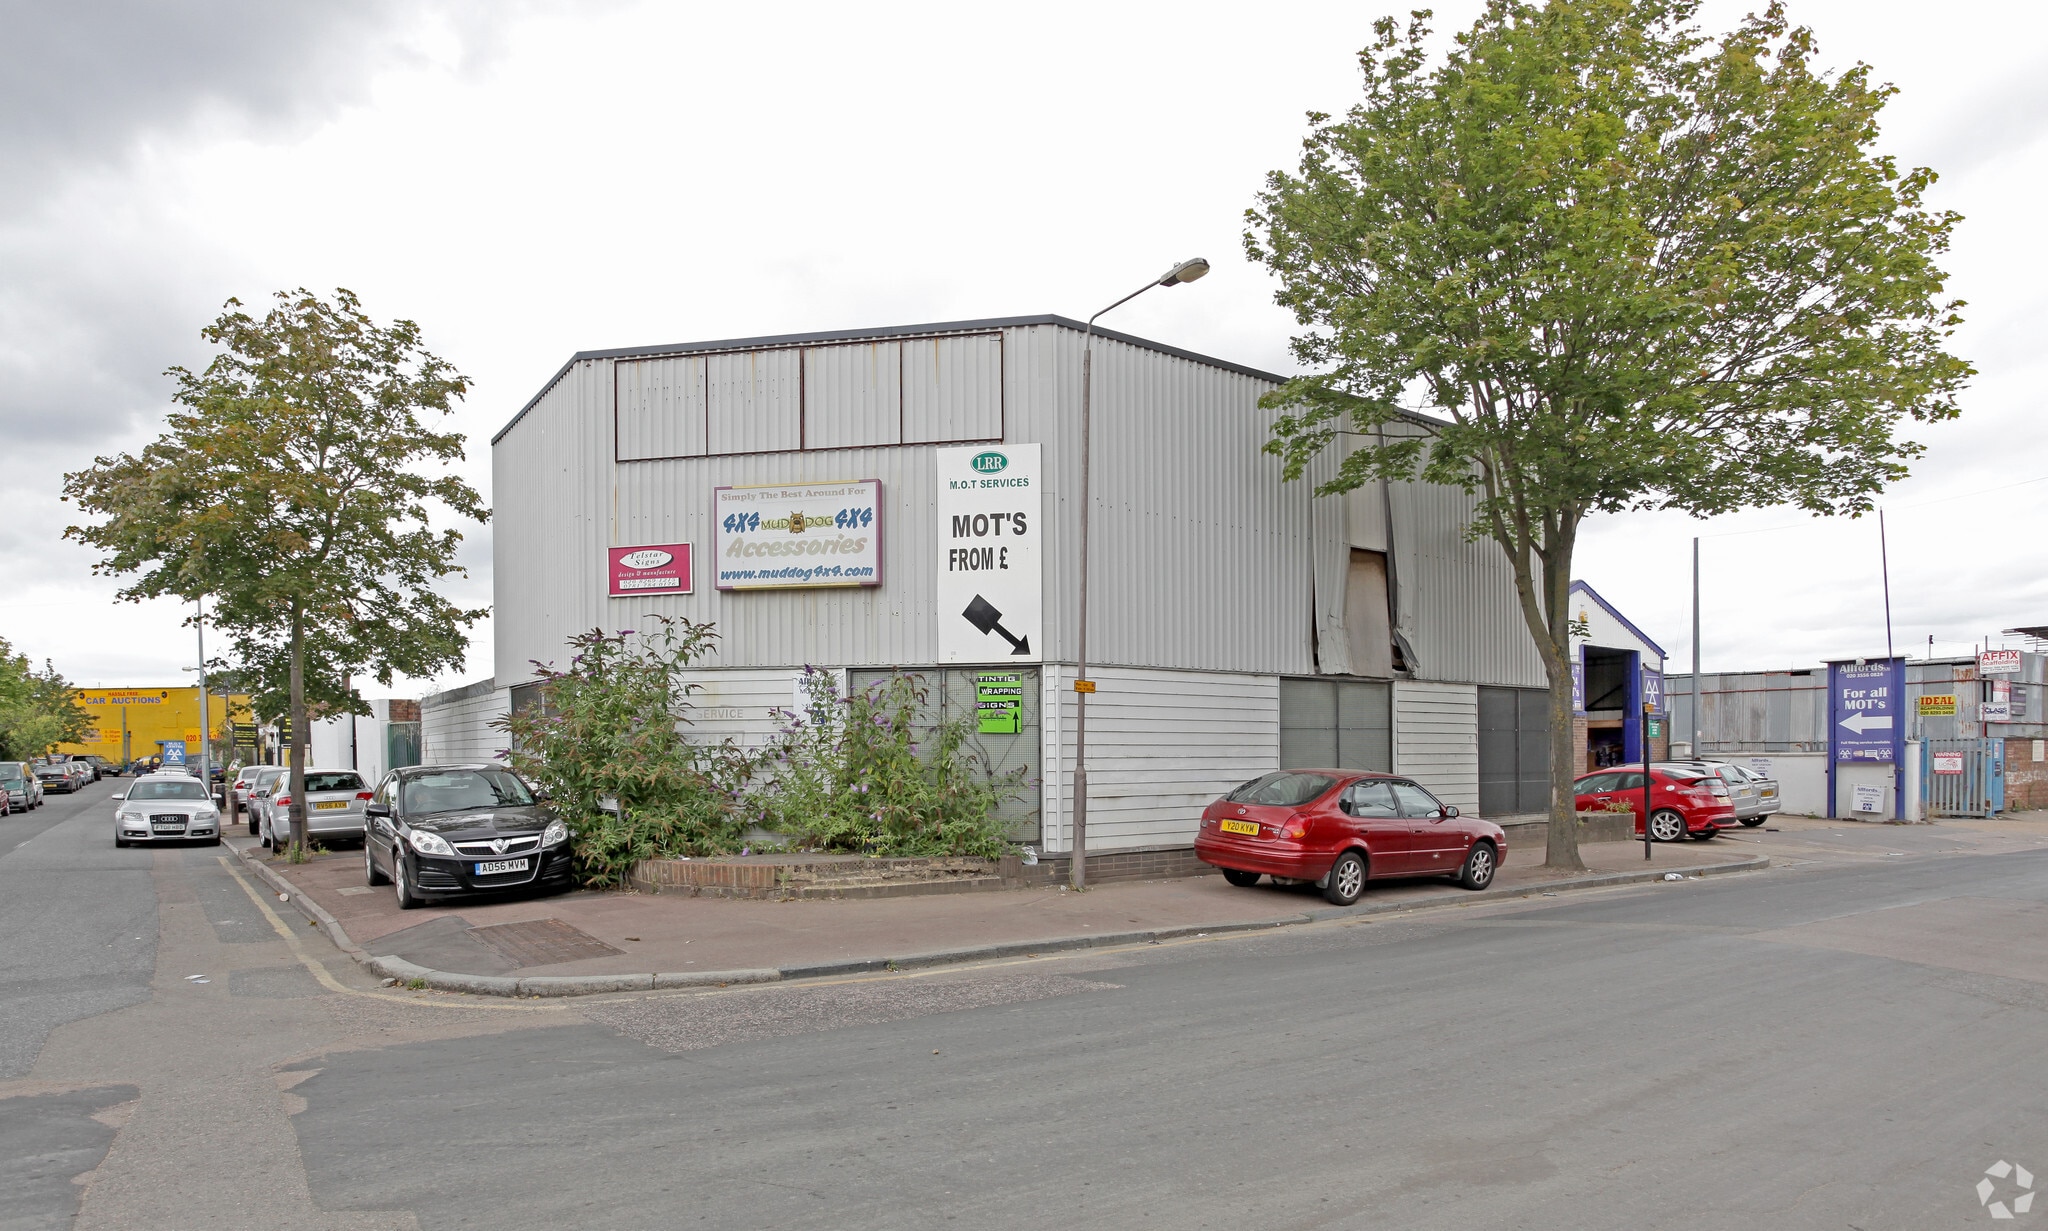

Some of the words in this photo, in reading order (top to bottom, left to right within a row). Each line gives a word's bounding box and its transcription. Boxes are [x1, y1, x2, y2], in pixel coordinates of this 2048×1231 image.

[977, 456, 1003, 470] LRR
[950, 480, 977, 490] M.O.T
[980, 478, 1029, 488] SERVICES
[721, 492, 756, 502] Simply
[759, 491, 778, 500] The
[781, 490, 802, 499] Best
[805, 488, 845, 498] Around
[848, 487, 866, 496] For
[761, 518, 790, 530] MUD
[805, 516, 834, 528] DOG
[952, 512, 1027, 538] MOT'S
[725, 533, 868, 559] Accessories
[950, 547, 993, 571] FROM
[999, 546, 1009, 570] £
[720, 565, 873, 582] www.muddog4x4.com
[1982, 651, 2018, 660] AFFIX
[1844, 688, 1866, 698] For
[1870, 687, 1887, 698] all
[112, 696, 161, 704] AUCTIONS
[1844, 699, 1886, 710] MOT's
[1920, 696, 1954, 705] IDEAL
[696, 708, 744, 719] SERVICE
[1227, 822, 1239, 830] Y20
[482, 862, 506, 872] AD56
[508, 859, 526, 869] MVM
